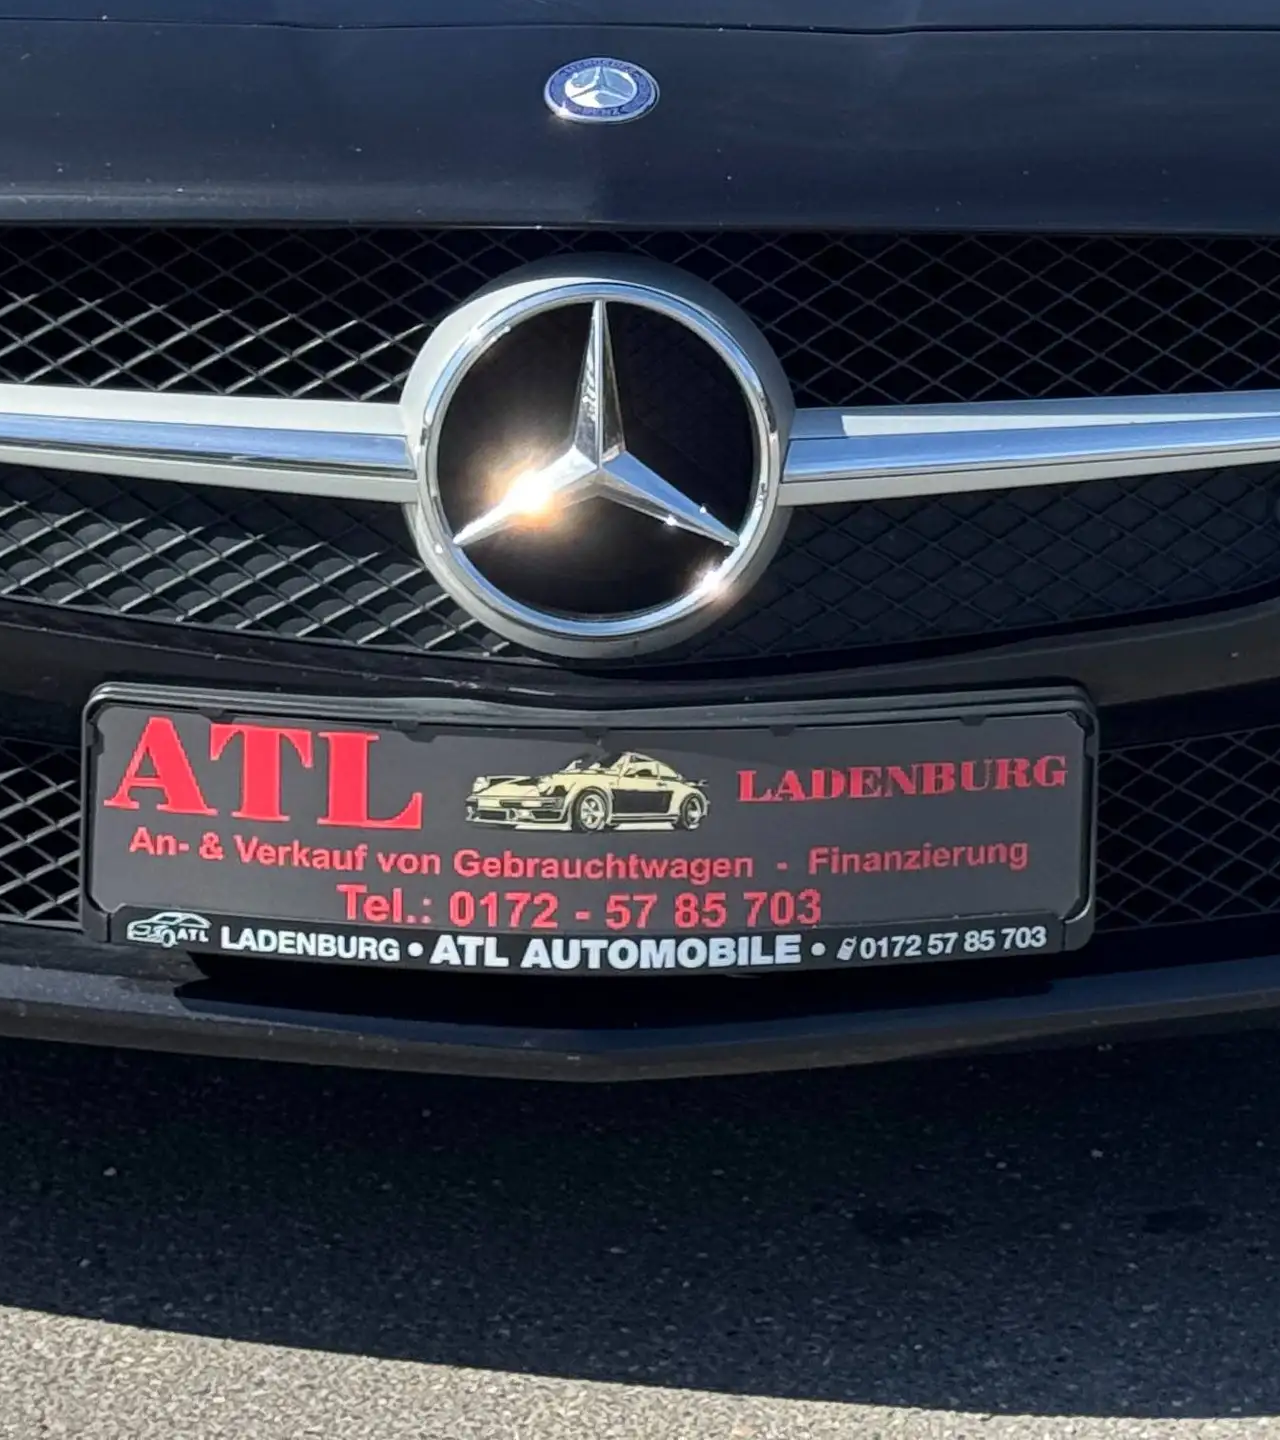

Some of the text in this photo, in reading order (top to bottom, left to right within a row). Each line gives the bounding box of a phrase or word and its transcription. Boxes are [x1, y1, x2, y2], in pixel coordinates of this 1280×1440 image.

[103, 716, 1067, 830] ATL LADENBURG
[129, 826, 189, 856] An-
[198, 831, 223, 860] &
[233, 834, 368, 872] Verkauf
[377, 851, 441, 876] von
[453, 848, 754, 886] Gebrauchtwagen
[808, 842, 1029, 875] Finanzierung
[336, 883, 432, 925] Tel.:
[449, 890, 558, 928] 0172
[606, 892, 658, 930] 57
[674, 891, 726, 929] 85
[743, 888, 822, 928] 703
[176, 930, 209, 943] ATL
[220, 925, 1048, 970] LADENBURG ATL AUTOMOBILE 0172 57 85 703
